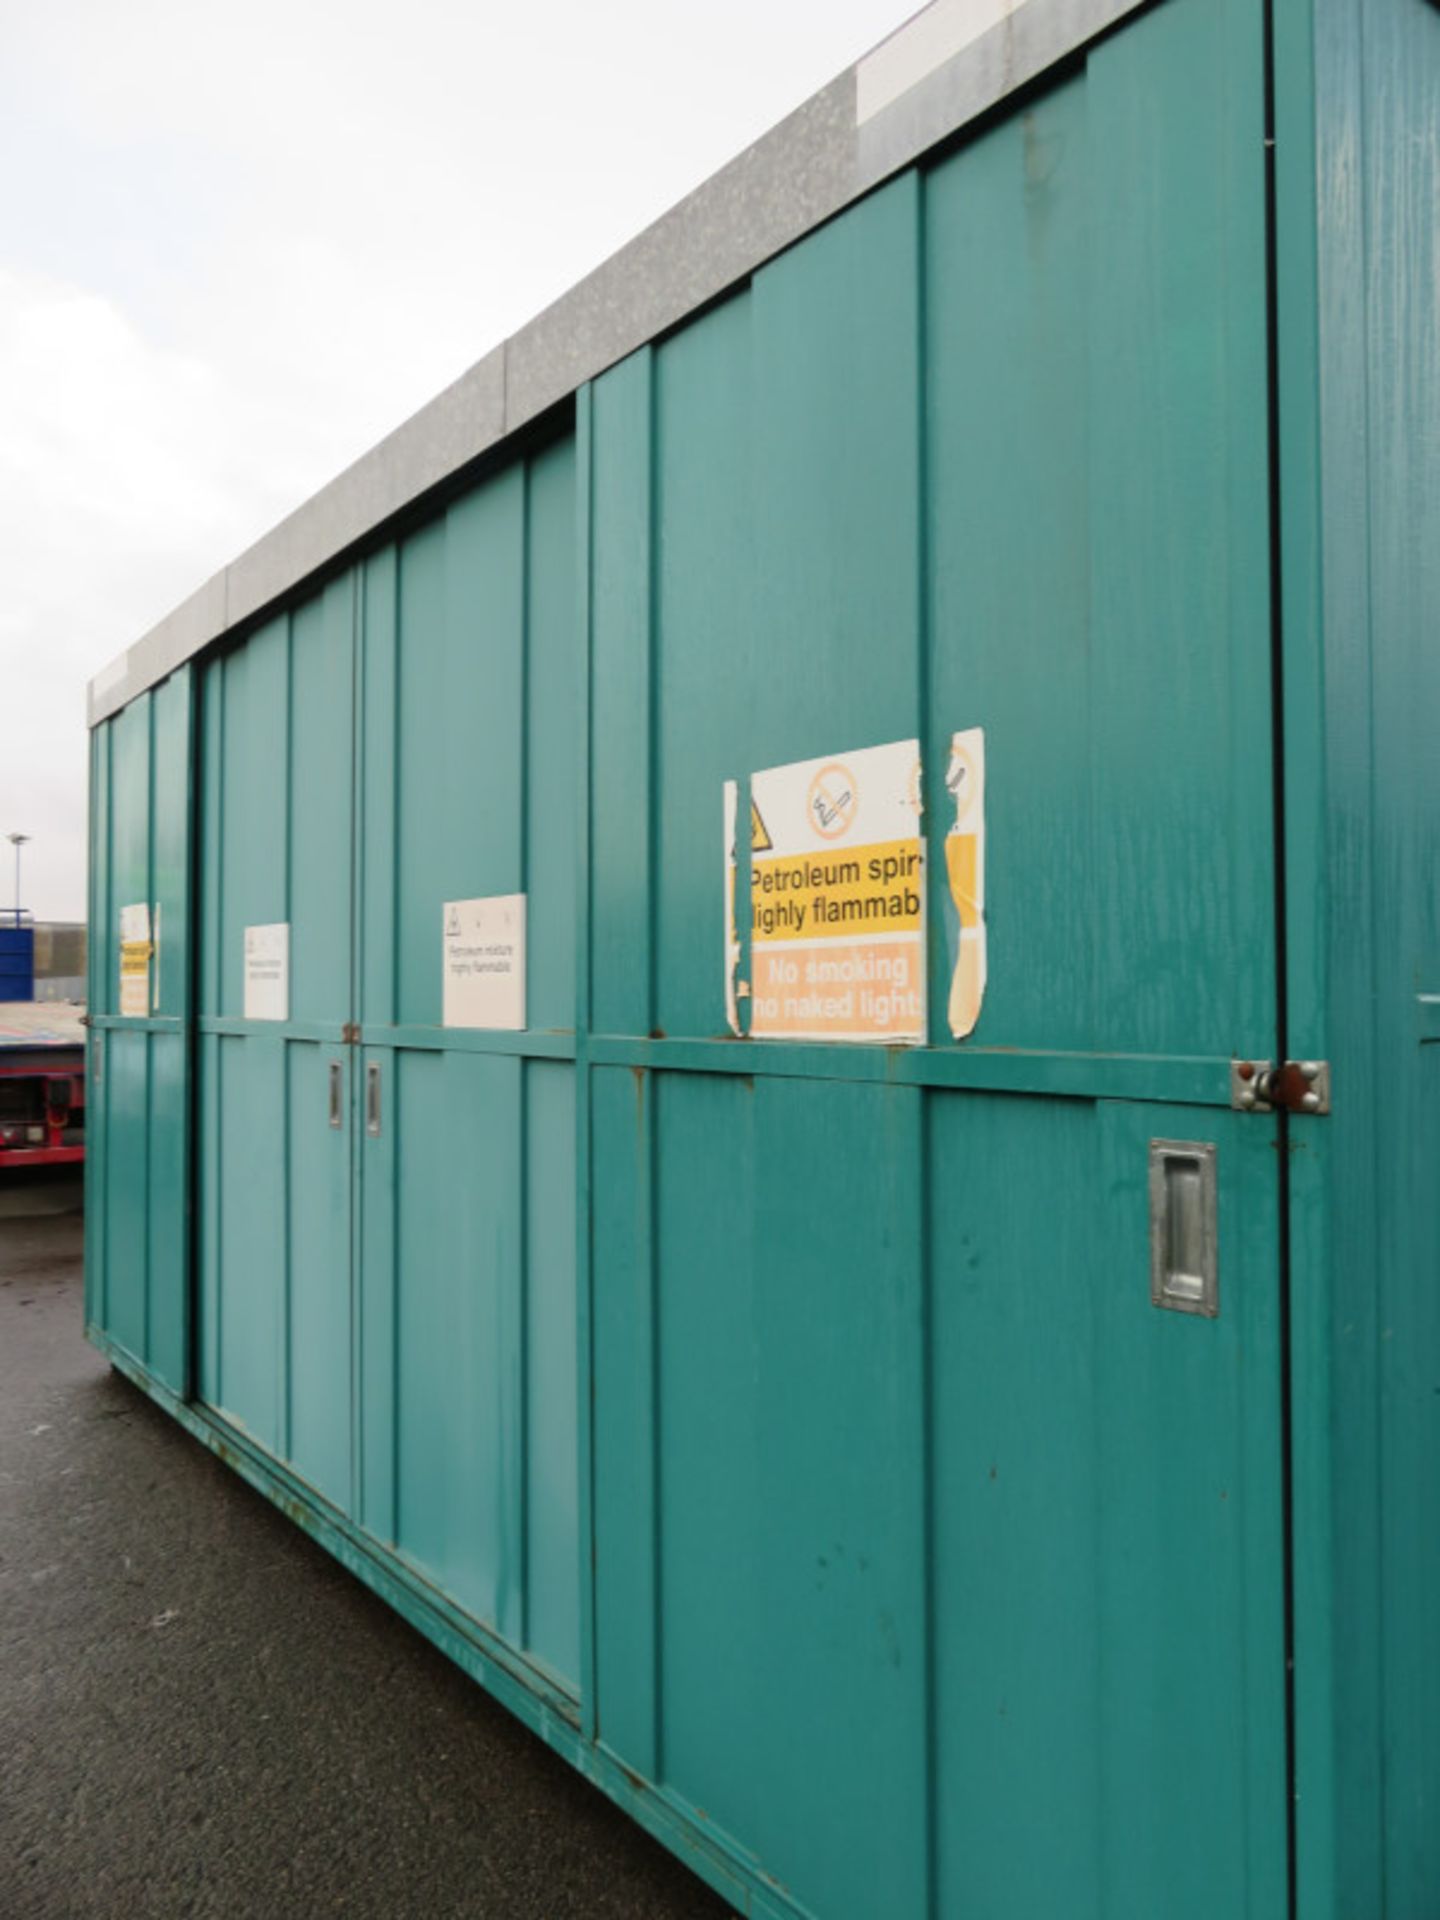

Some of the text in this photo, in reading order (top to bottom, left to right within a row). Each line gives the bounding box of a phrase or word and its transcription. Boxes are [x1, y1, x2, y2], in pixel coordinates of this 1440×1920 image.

[752, 849, 922, 893] Petroleum spir
[752, 899, 806, 934] ighly
[769, 951, 909, 987] No smoking
[784, 990, 854, 1018] naked
